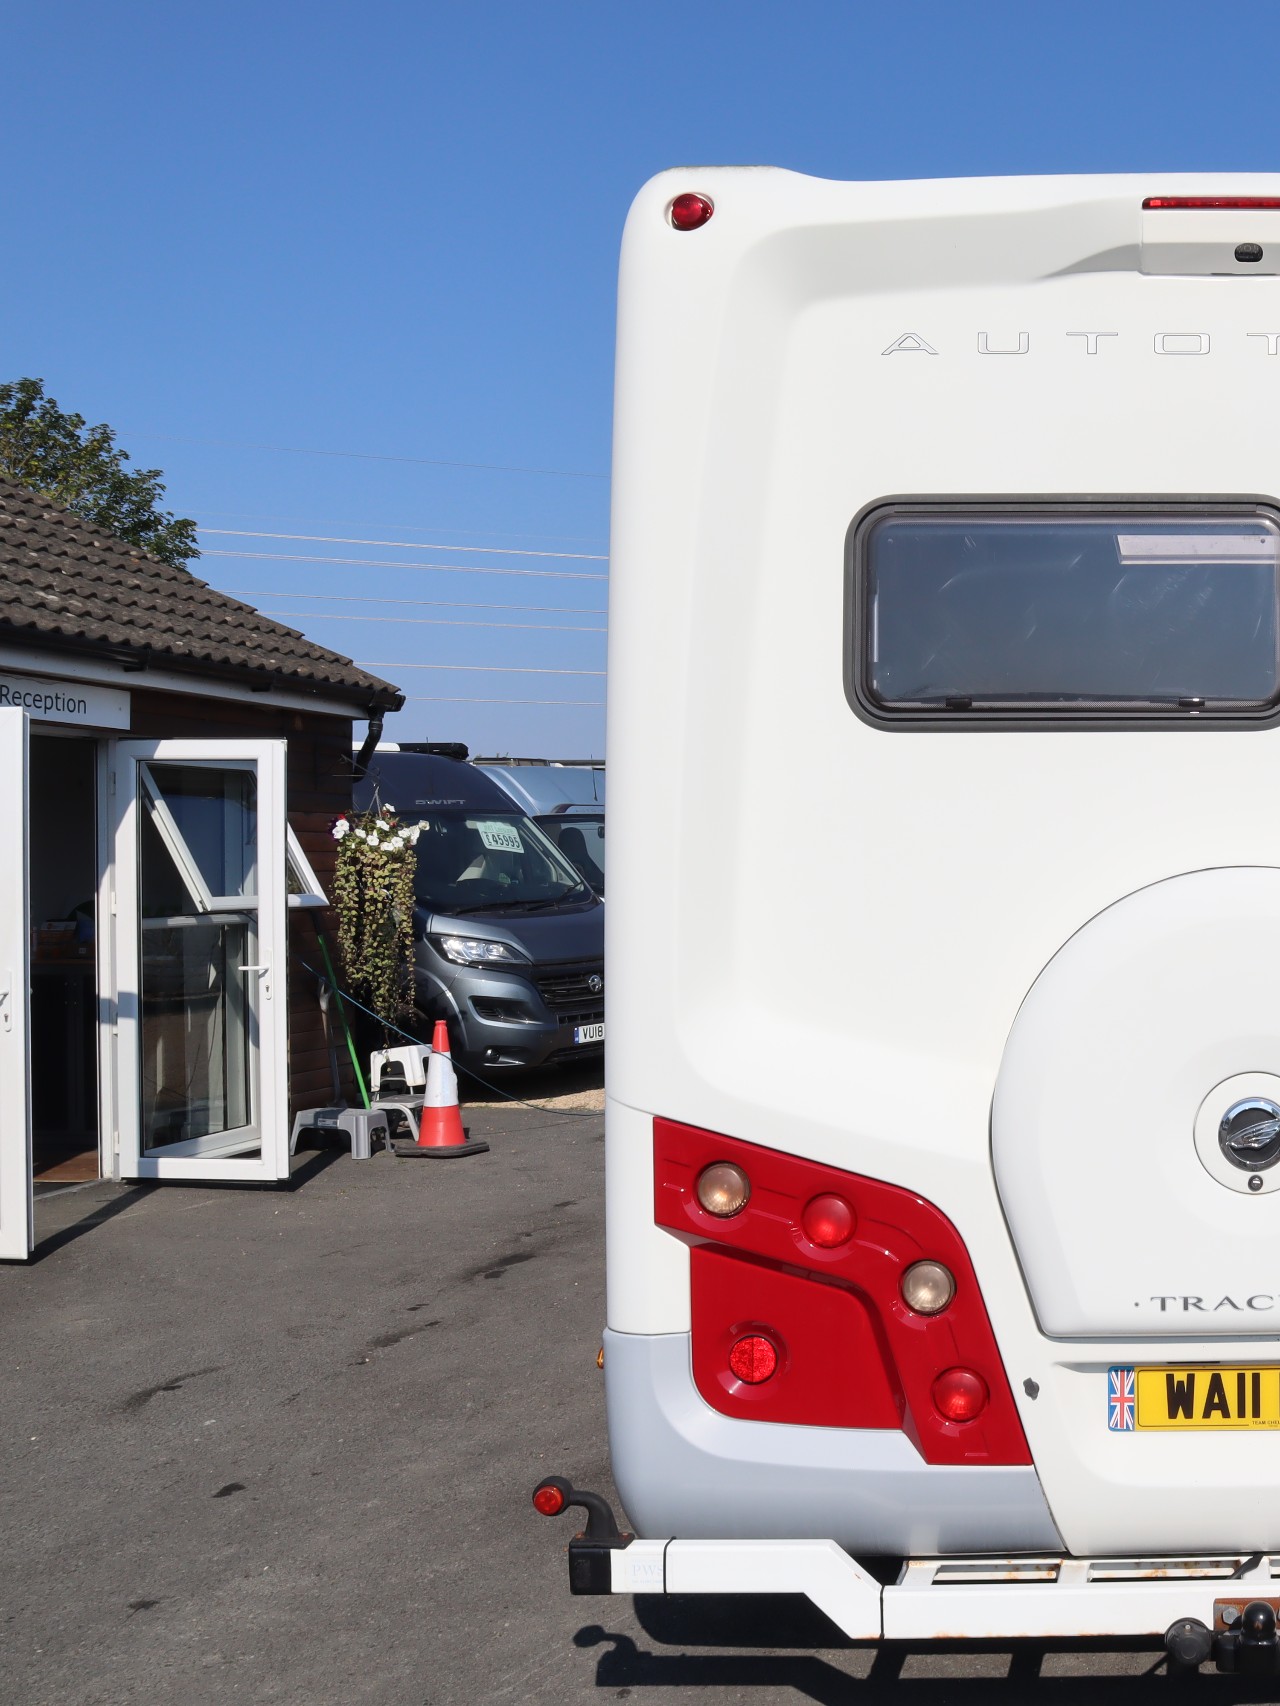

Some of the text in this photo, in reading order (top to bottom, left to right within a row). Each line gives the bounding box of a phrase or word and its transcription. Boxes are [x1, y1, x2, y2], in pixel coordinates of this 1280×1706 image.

[0, 684, 87, 715] Reception
[485, 832, 521, 849] £45995
[1165, 1372, 1261, 1420] WA11
